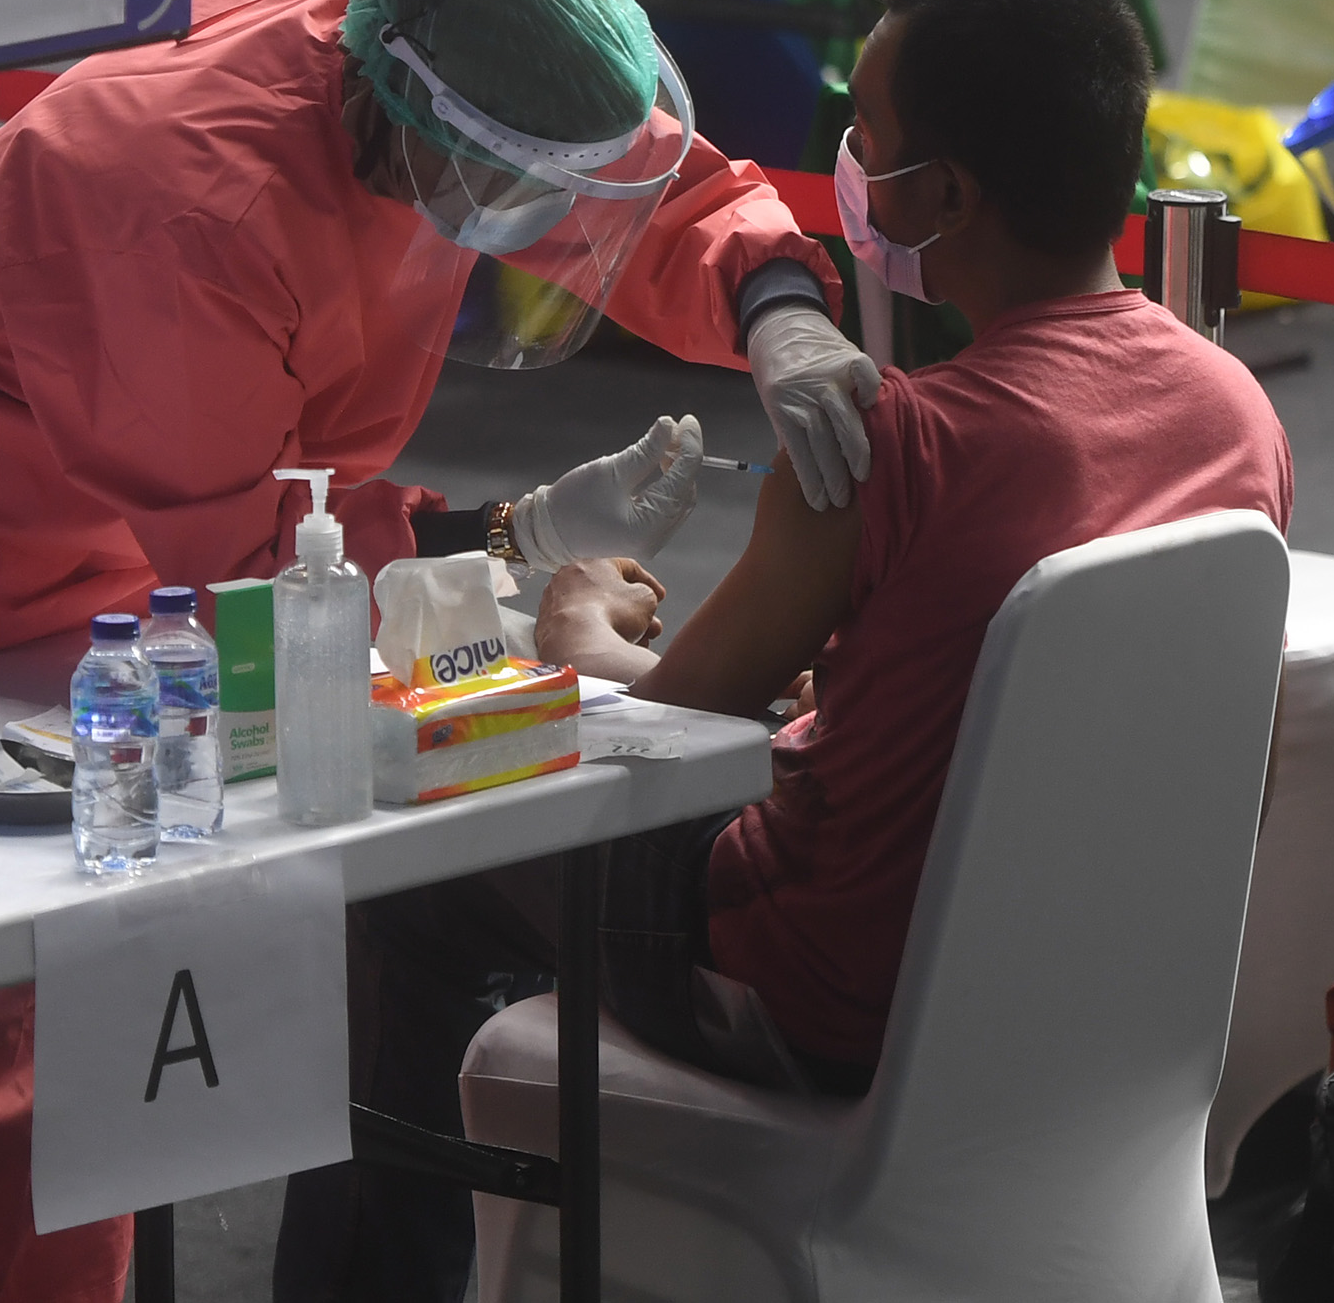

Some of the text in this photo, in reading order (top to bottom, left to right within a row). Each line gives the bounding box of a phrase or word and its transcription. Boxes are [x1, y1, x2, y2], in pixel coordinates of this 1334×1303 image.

[229, 722, 269, 740] Alcohol
[230, 734, 265, 751] Swabs
[144, 968, 220, 1103] A
